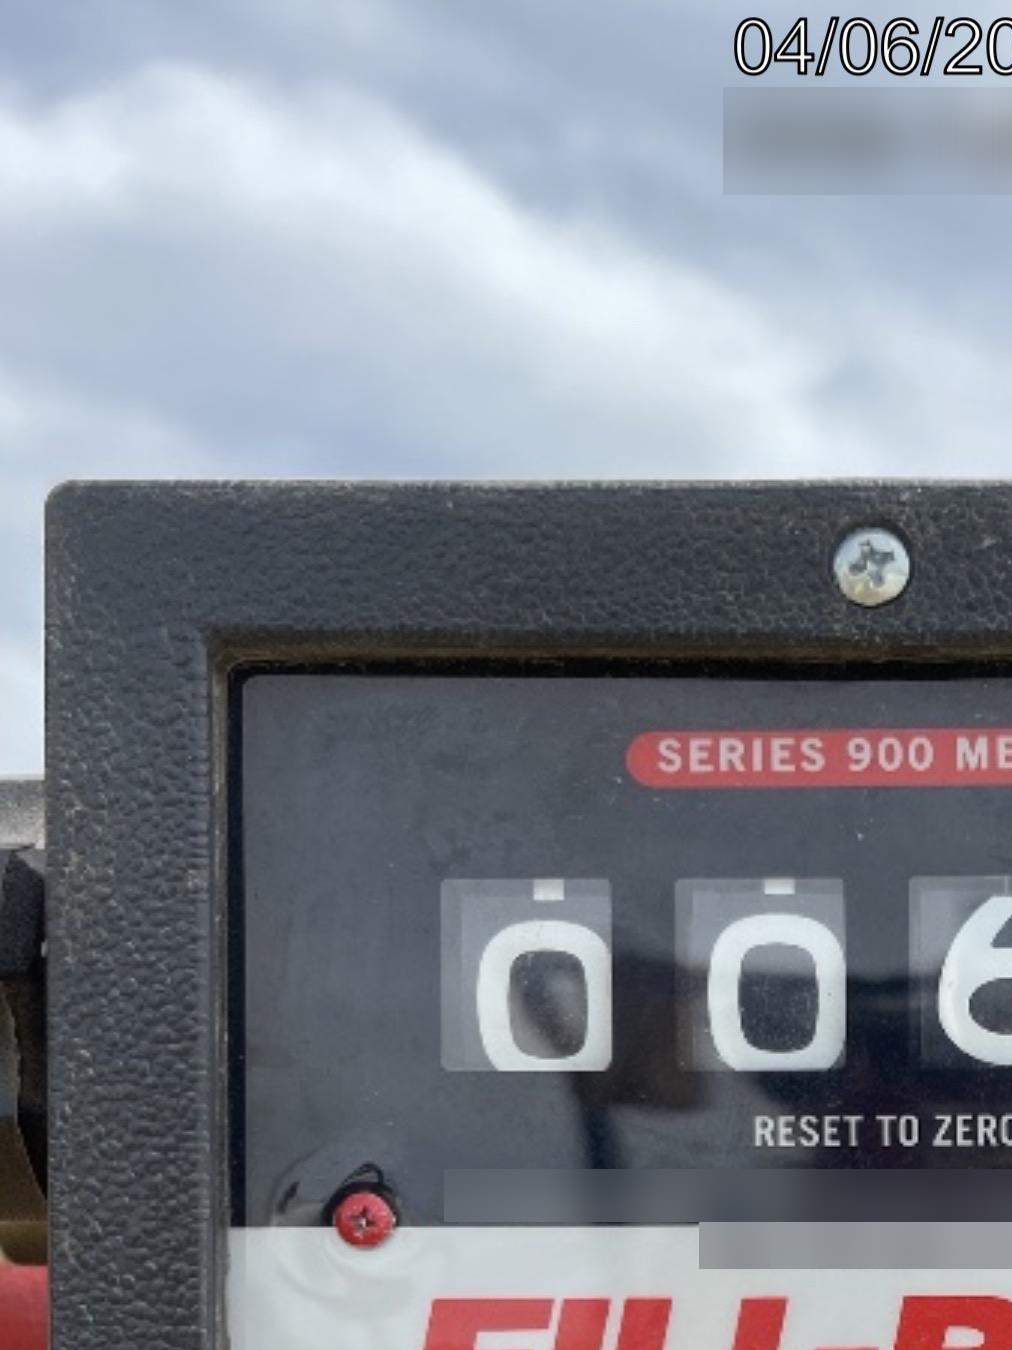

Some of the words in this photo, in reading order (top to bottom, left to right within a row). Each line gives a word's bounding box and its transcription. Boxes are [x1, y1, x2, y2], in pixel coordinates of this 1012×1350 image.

[657, 737, 826, 773] SERIES
[847, 736, 935, 771] 900
[753, 1114, 861, 1148] RESET
[876, 1114, 919, 1148] TO
